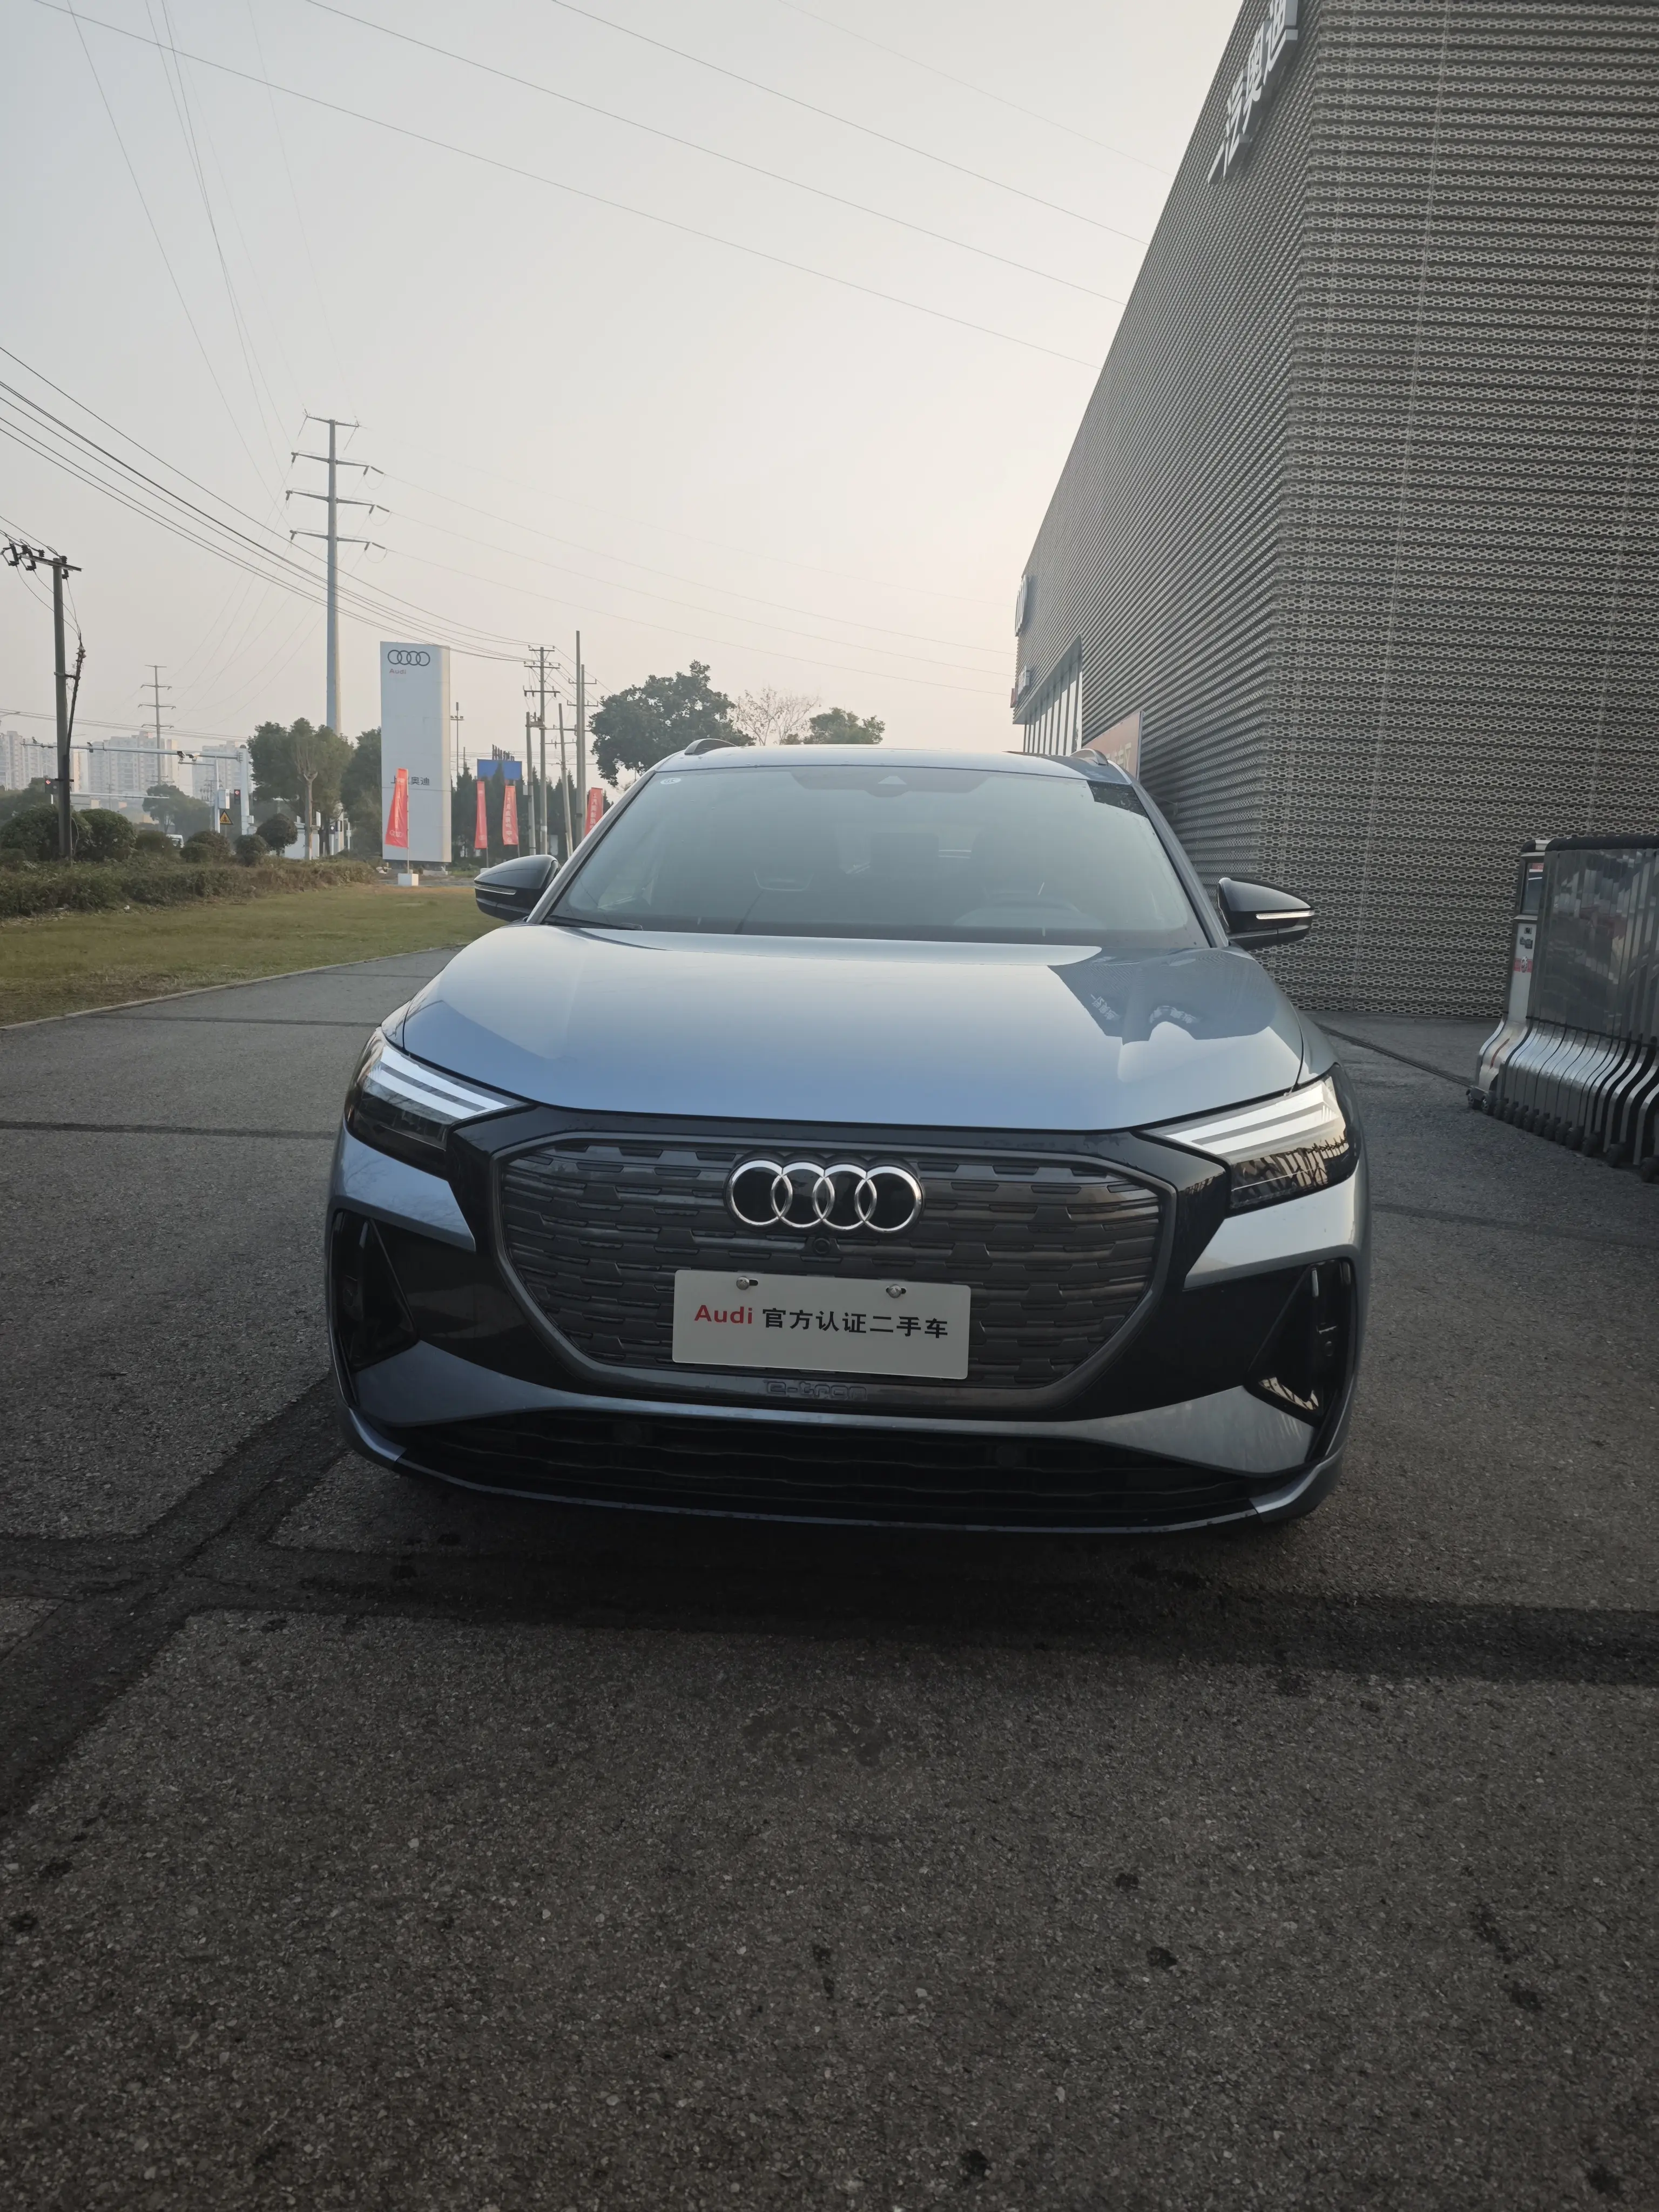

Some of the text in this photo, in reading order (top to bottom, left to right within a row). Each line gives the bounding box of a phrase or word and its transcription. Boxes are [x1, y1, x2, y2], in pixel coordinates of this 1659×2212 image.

[390, 775, 430, 786] 上奥迪
[694, 1305, 948, 1338] Audi 官方认证二手车
[767, 1381, 867, 1401] e-tron
